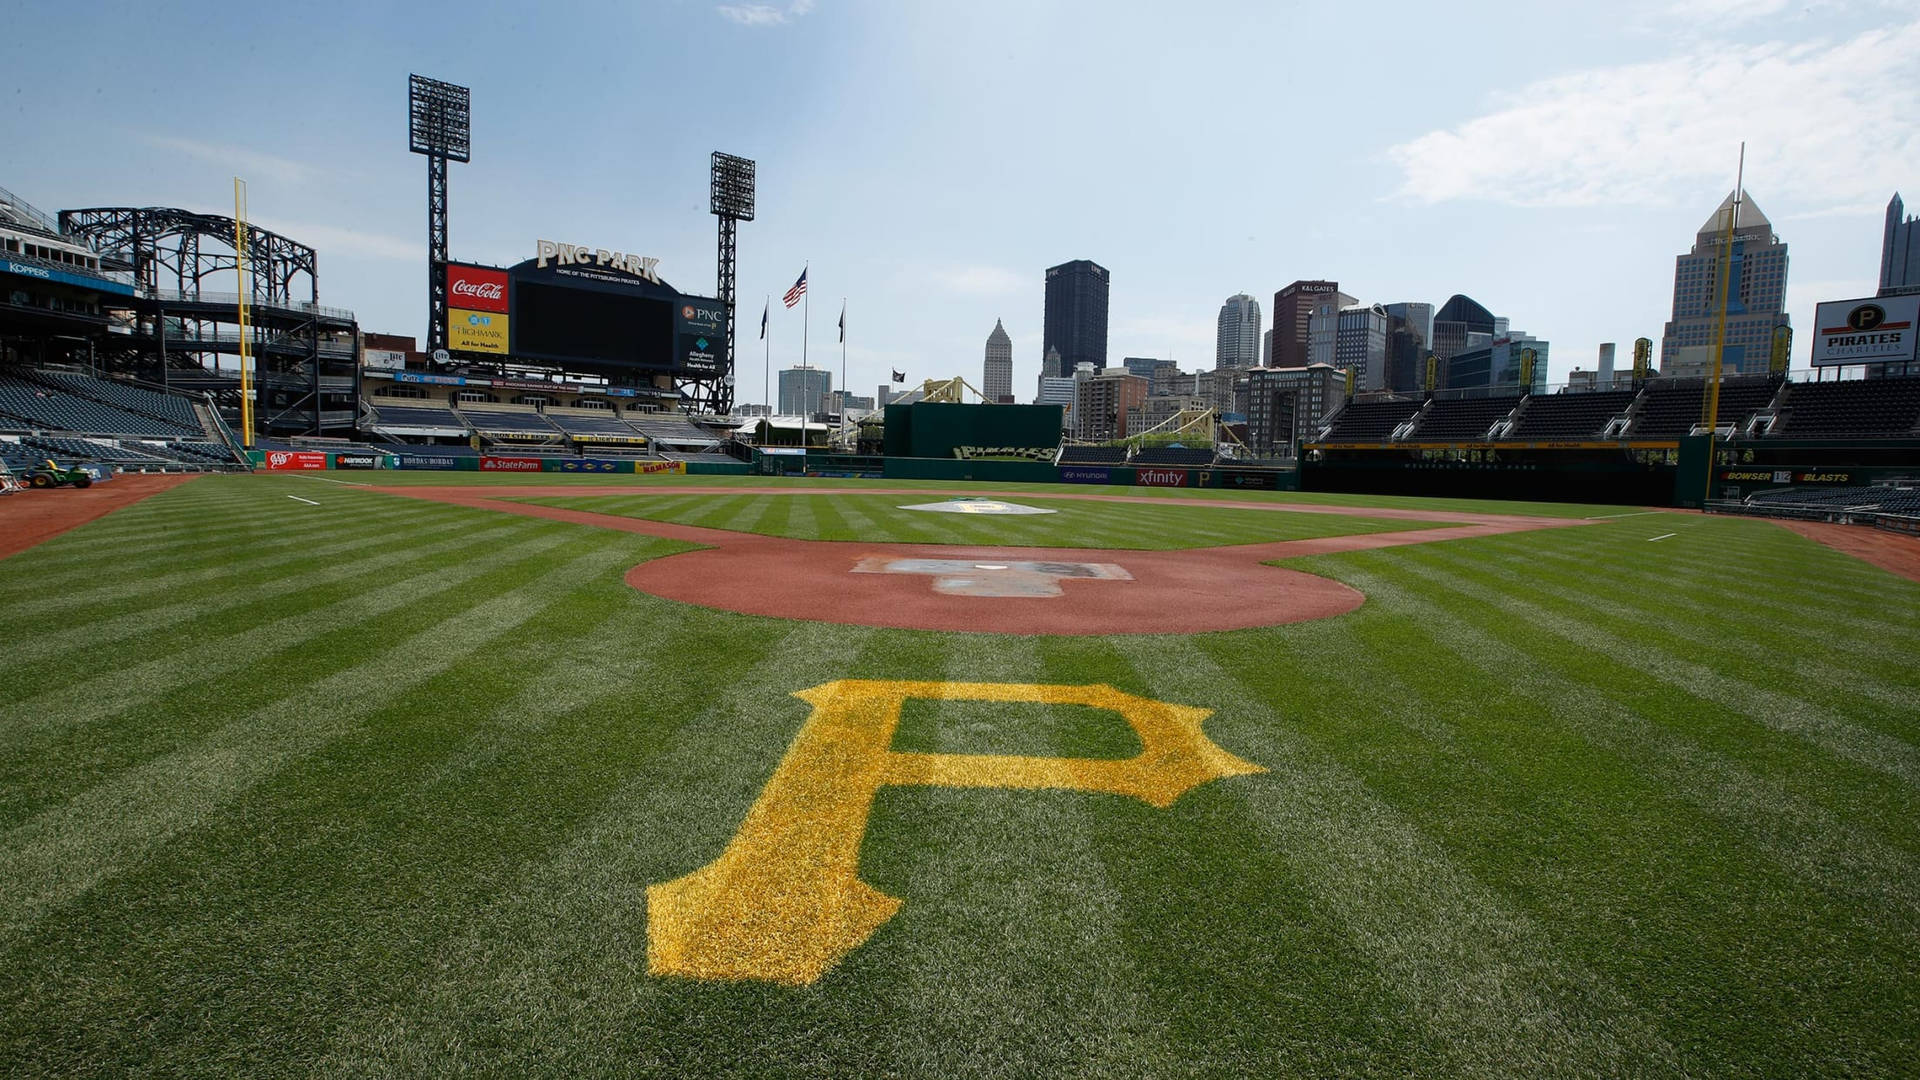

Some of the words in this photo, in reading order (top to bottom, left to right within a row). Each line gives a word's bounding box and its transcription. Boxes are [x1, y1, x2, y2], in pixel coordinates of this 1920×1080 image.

[9, 262, 49, 278] KOPPERS
[537, 240, 591, 268] PNC
[596, 249, 660, 285] PARK
[590, 273, 620, 282] PITTSBURGH
[453, 279, 504, 299] Coca-Cola
[697, 308, 721, 322] PNC
[1859, 310, 1876, 326] P
[1828, 333, 1901, 347] PIRATES
[1827, 344, 1900, 355] CHARITIES
[1140, 470, 1183, 486] xfinity
[647, 679, 1269, 985] P
